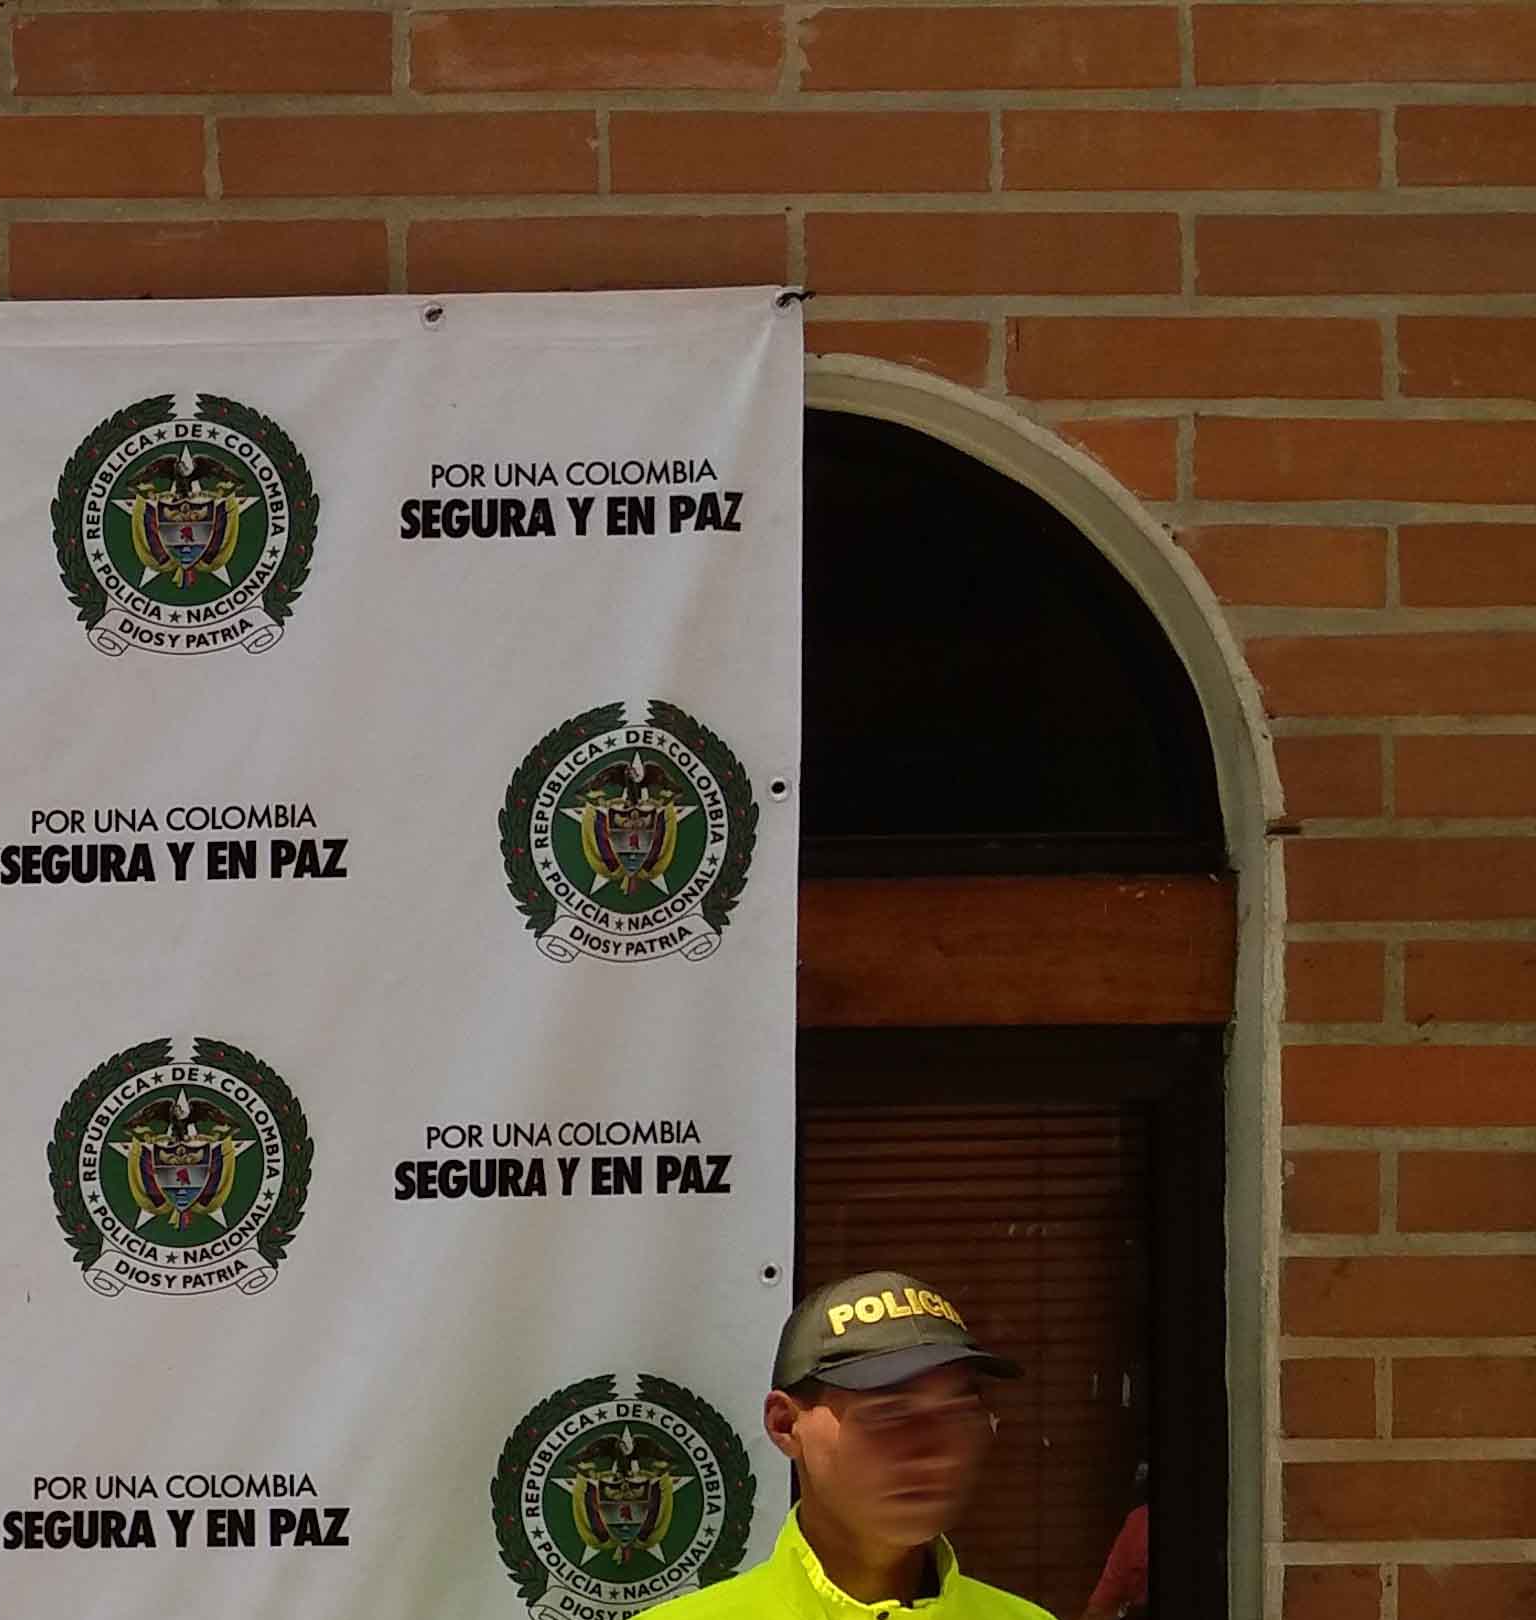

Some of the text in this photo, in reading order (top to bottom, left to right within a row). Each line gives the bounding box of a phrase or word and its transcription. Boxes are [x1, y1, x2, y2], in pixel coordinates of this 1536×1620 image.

[175, 424, 203, 438] DE
[224, 433, 286, 537] COLOMBIA
[187, 555, 276, 624] NACIONAL
[186, 619, 254, 649] PATRIA
[31, 802, 318, 835] POR UNA COLOMBIA
[0, 837, 350, 886] SEGURA Y EN PAZ
[426, 1119, 702, 1151] POR UNA COLOMBIA
[393, 1153, 733, 1201] SEGURA Y EN PAZ
